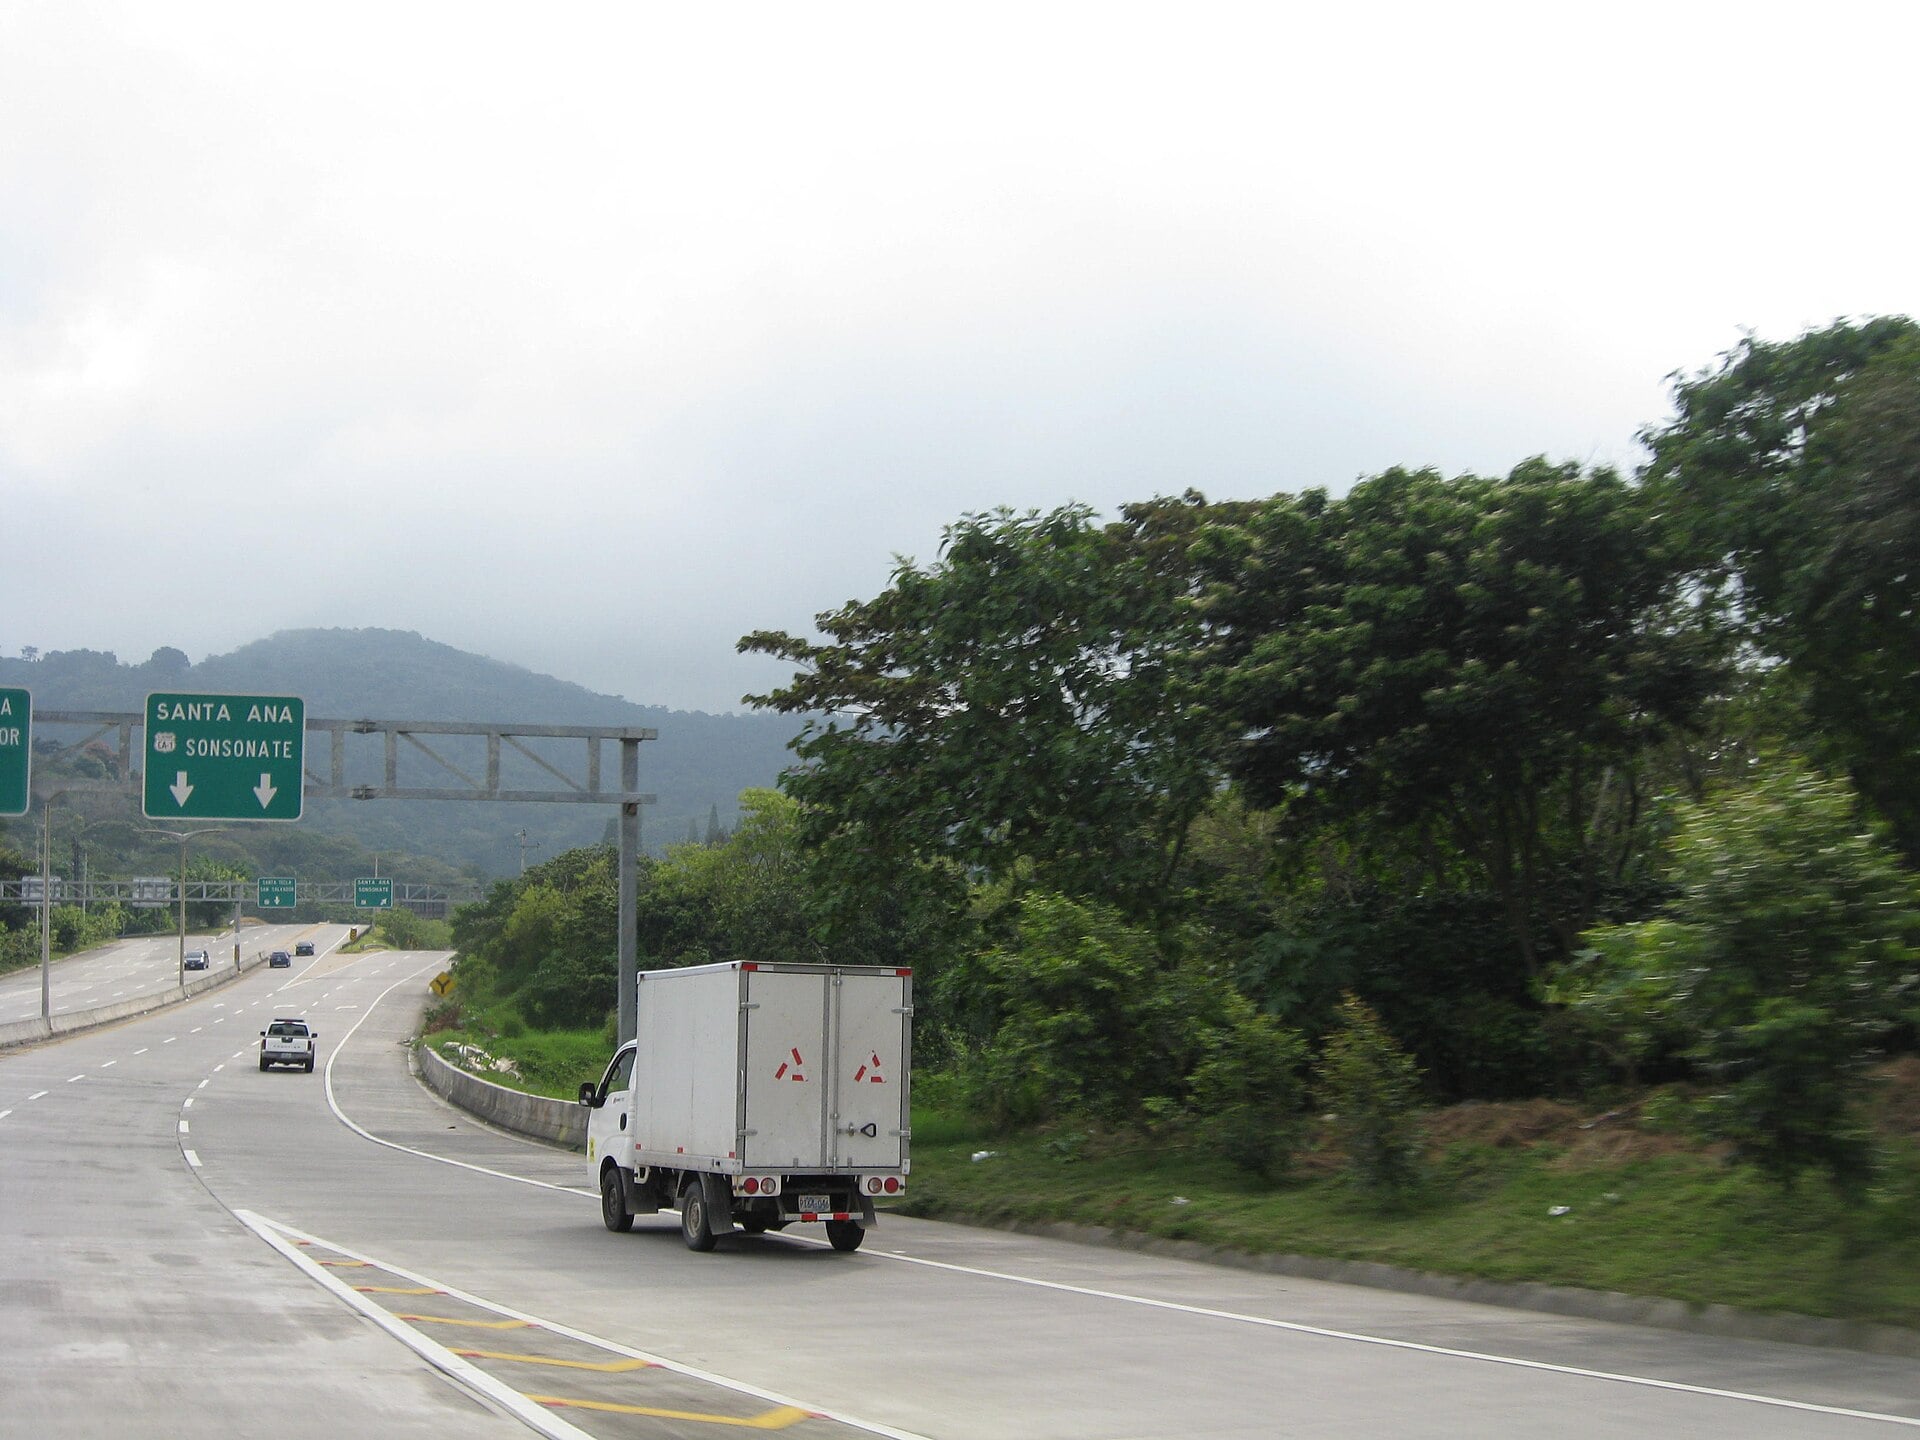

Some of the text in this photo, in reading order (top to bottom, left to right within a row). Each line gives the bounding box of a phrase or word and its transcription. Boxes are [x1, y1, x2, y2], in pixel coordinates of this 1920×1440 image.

[157, 703, 293, 723] SANTA ANA
[185, 738, 293, 759] SONSONATE
